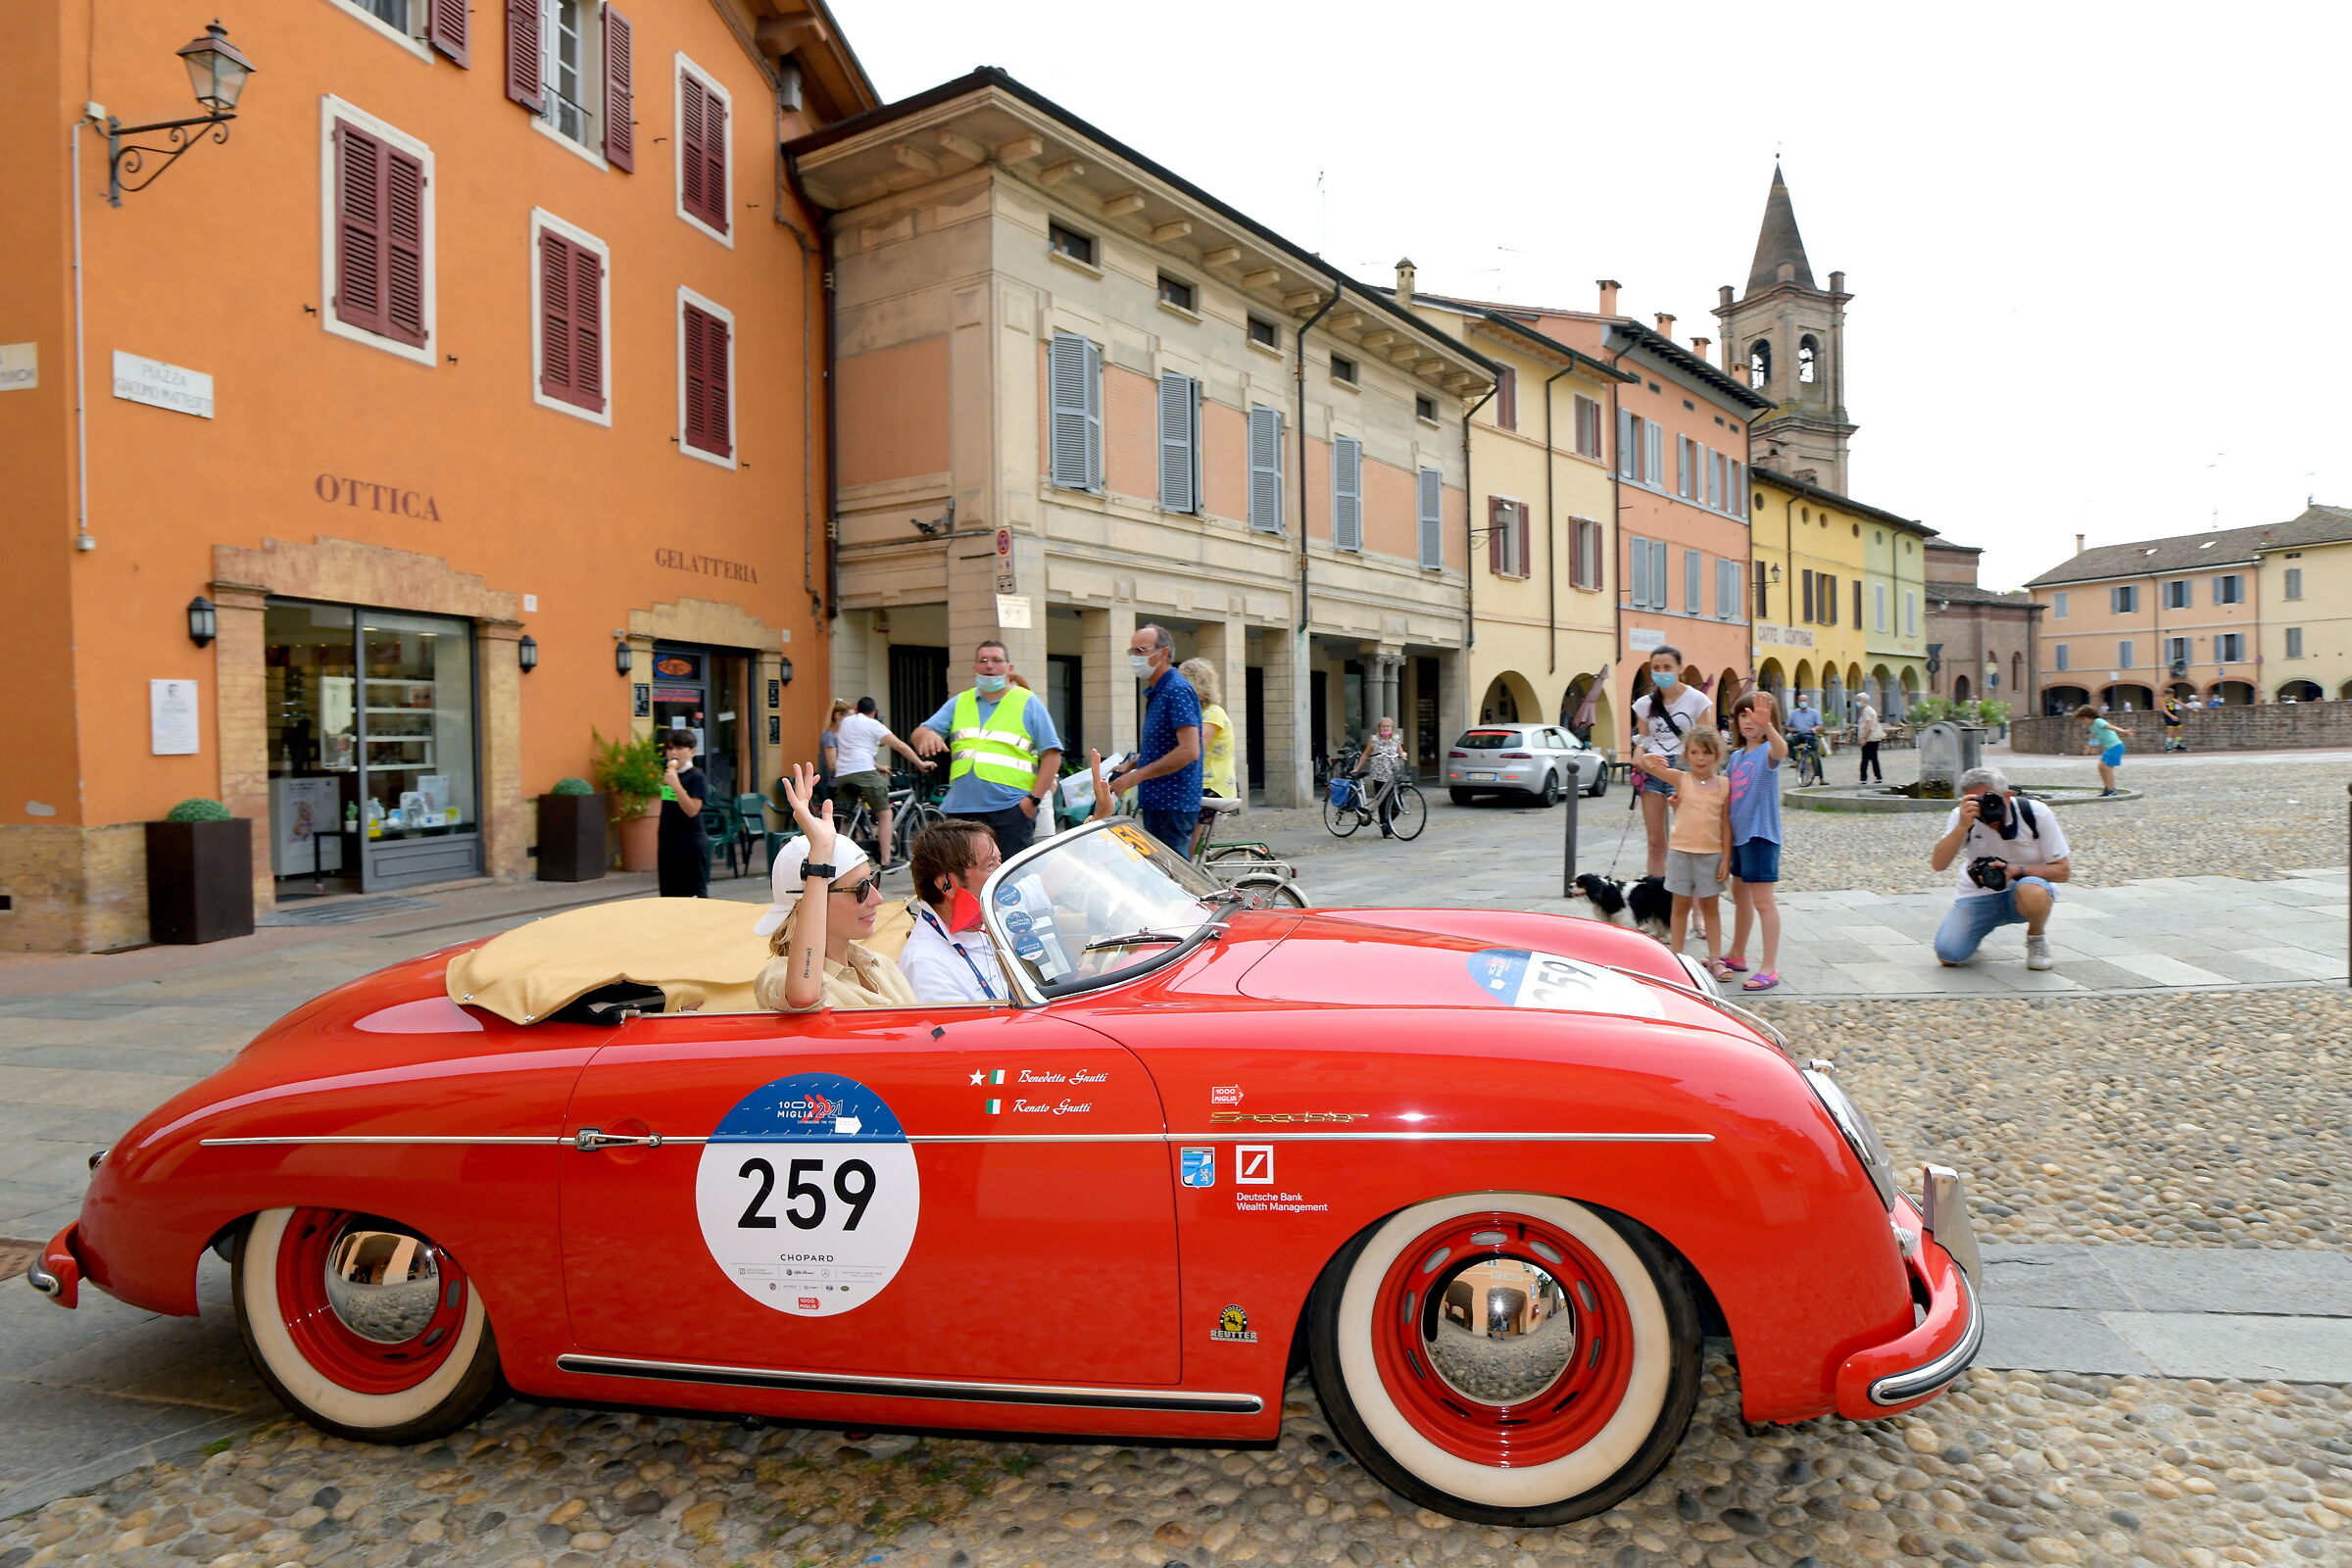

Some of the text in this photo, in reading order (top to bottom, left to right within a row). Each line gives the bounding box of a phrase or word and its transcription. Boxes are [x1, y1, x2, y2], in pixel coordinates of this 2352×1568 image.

[142, 364, 187, 387] PIAZZA
[315, 473, 442, 522] OTTICA
[655, 547, 758, 584] GELATTERIA
[1018, 1068, 1108, 1085] Benedetta Gnutti
[778, 1099, 843, 1118] 1000 2021
[1012, 1098, 1092, 1115] Renato Gnutti
[738, 1157, 877, 1231] 259
[1237, 1193, 1302, 1201] Deutsche Bank
[1236, 1202, 1328, 1213] Wealth Management
[780, 1253, 834, 1262] CHOPARD
[1210, 1329, 1258, 1340] REUTTER
